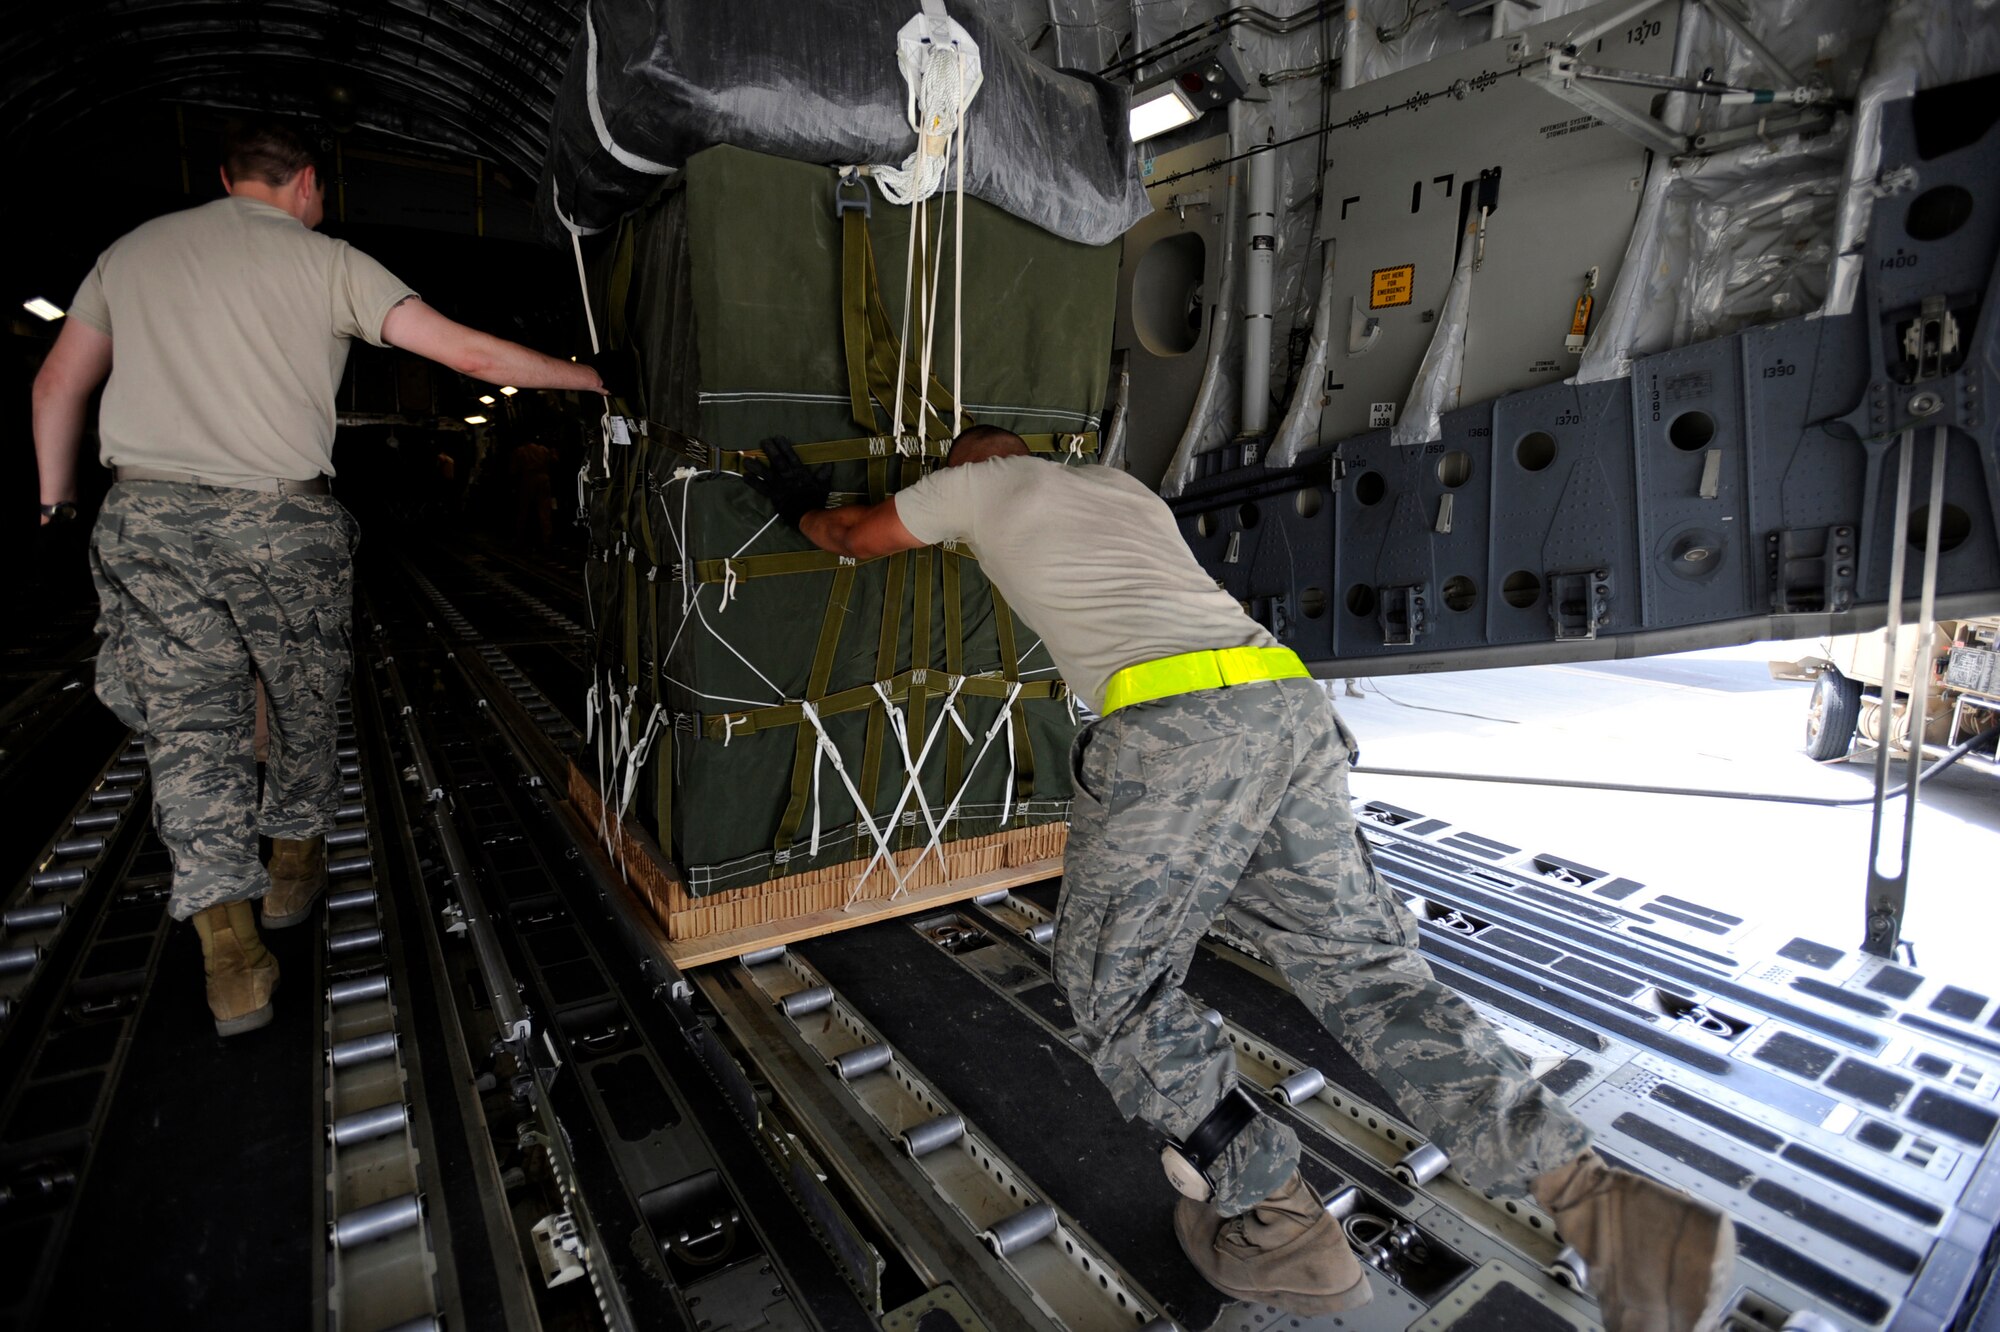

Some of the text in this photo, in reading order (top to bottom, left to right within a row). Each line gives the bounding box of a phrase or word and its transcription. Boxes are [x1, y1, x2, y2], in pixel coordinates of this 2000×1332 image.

[1627, 21, 1661, 44] 1370
[1471, 71, 1497, 90] 1350
[1406, 92, 1430, 110] 1340
[1540, 115, 1592, 134] DEFENSIVE SYSTEM
[1546, 128, 1568, 139] STOWED
[1569, 123, 1590, 133] BEHIND
[1880, 254, 1917, 270] 1400
[1377, 286, 1406, 296] EMERGENCY
[1763, 364, 1796, 378] 1390
[1373, 404, 1392, 412] AD 24
[1652, 381, 1661, 422] 1380
[1373, 418, 1390, 426] 1338
[1555, 416, 1580, 425] 1370
[1468, 428, 1489, 437] 1360
[1425, 445, 1445, 454] 1350
[1350, 459, 1367, 468] 1340
